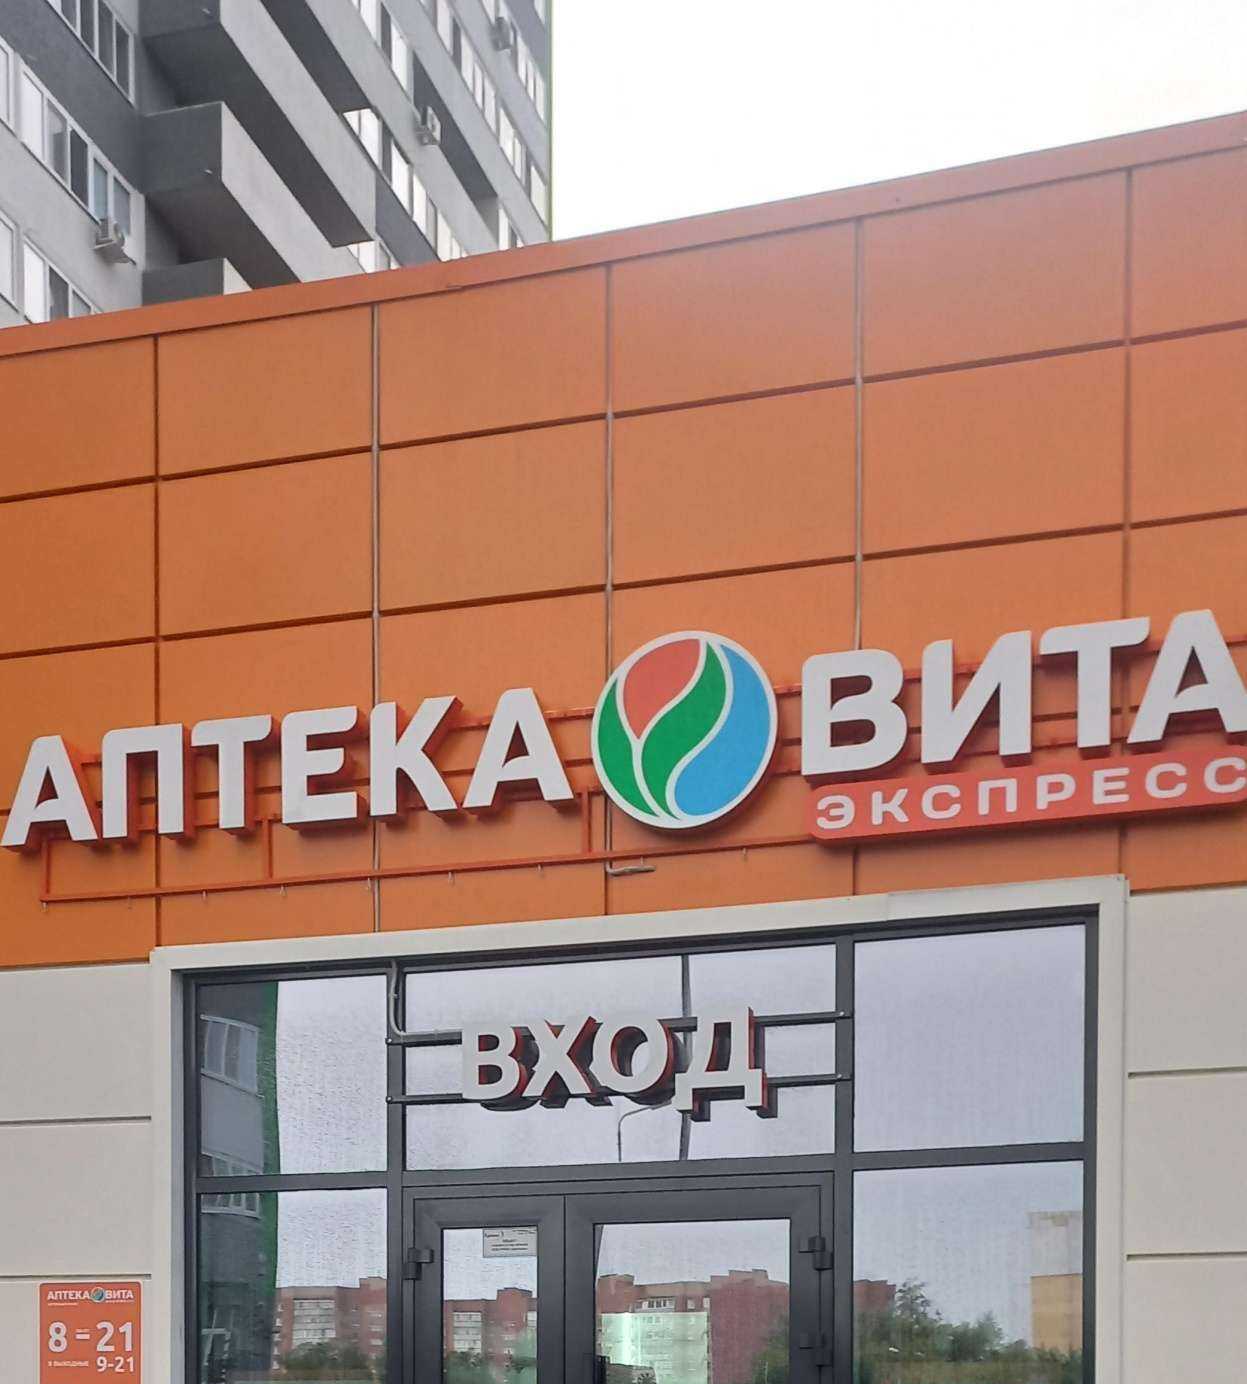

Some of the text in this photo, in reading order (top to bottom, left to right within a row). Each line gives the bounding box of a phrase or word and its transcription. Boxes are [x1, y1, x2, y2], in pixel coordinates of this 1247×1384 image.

[1, 608, 1247, 847] АПТЕКА ВИТА
[815, 755, 1247, 830] ЭКСПРЕСС
[462, 1007, 763, 1111] ВХОД
[47, 1289, 134, 1300] АПТЕКА ВИТА
[48, 1321, 68, 1353] 8
[96, 1321, 134, 1352] 21
[96, 1356, 135, 1373] 9-21
